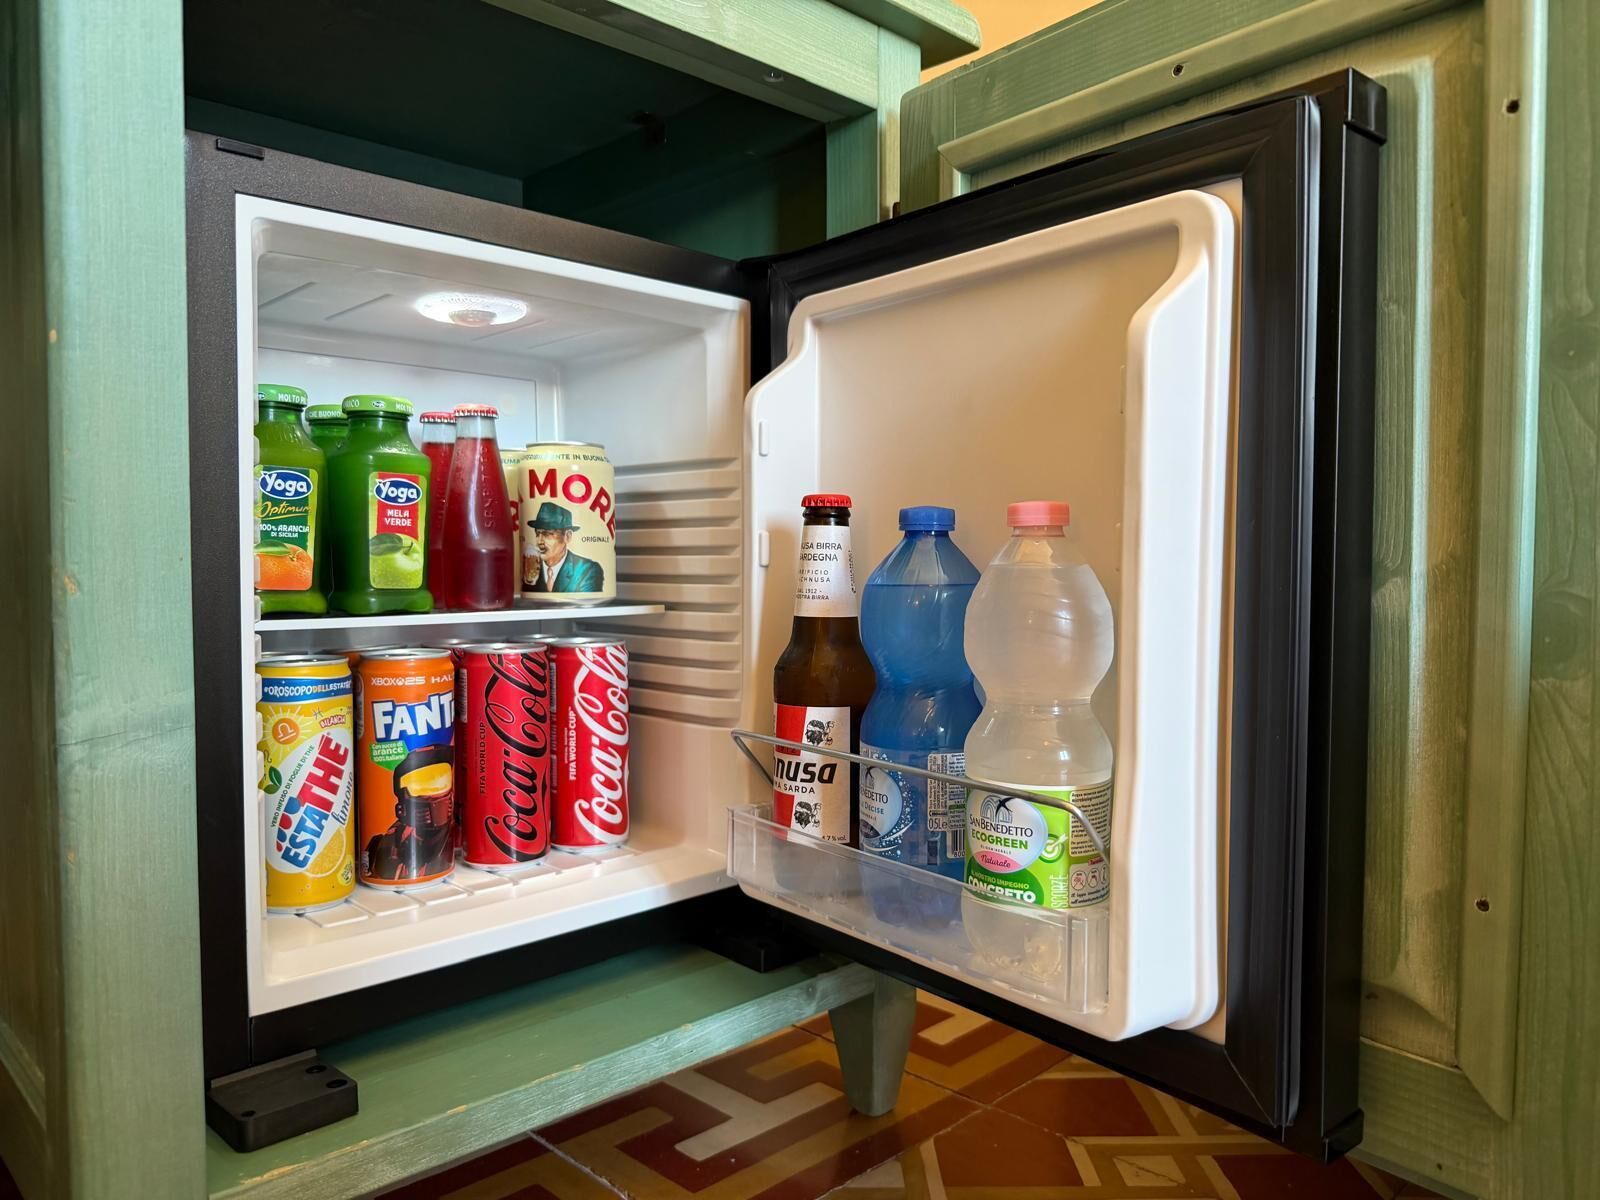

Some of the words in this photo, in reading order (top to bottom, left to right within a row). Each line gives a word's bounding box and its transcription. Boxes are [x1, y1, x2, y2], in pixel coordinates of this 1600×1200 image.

[264, 472, 308, 496] Yoga
[379, 479, 417, 502] Yoga
[387, 509, 409, 517] MELA
[384, 518, 412, 527] VERDE
[816, 542, 842, 550] BIRRA
[373, 747, 403, 756] arance
[569, 729, 577, 761] WORLD
[574, 646, 629, 844] Coca-Cola
[569, 762, 577, 781] FIFA
[774, 756, 837, 784] nusa
[783, 783, 815, 794] SARDA
[971, 829, 1028, 850] ECOGREEN
[980, 854, 1011, 868] Naturale
[997, 879, 1030, 890] IMPEGNO
